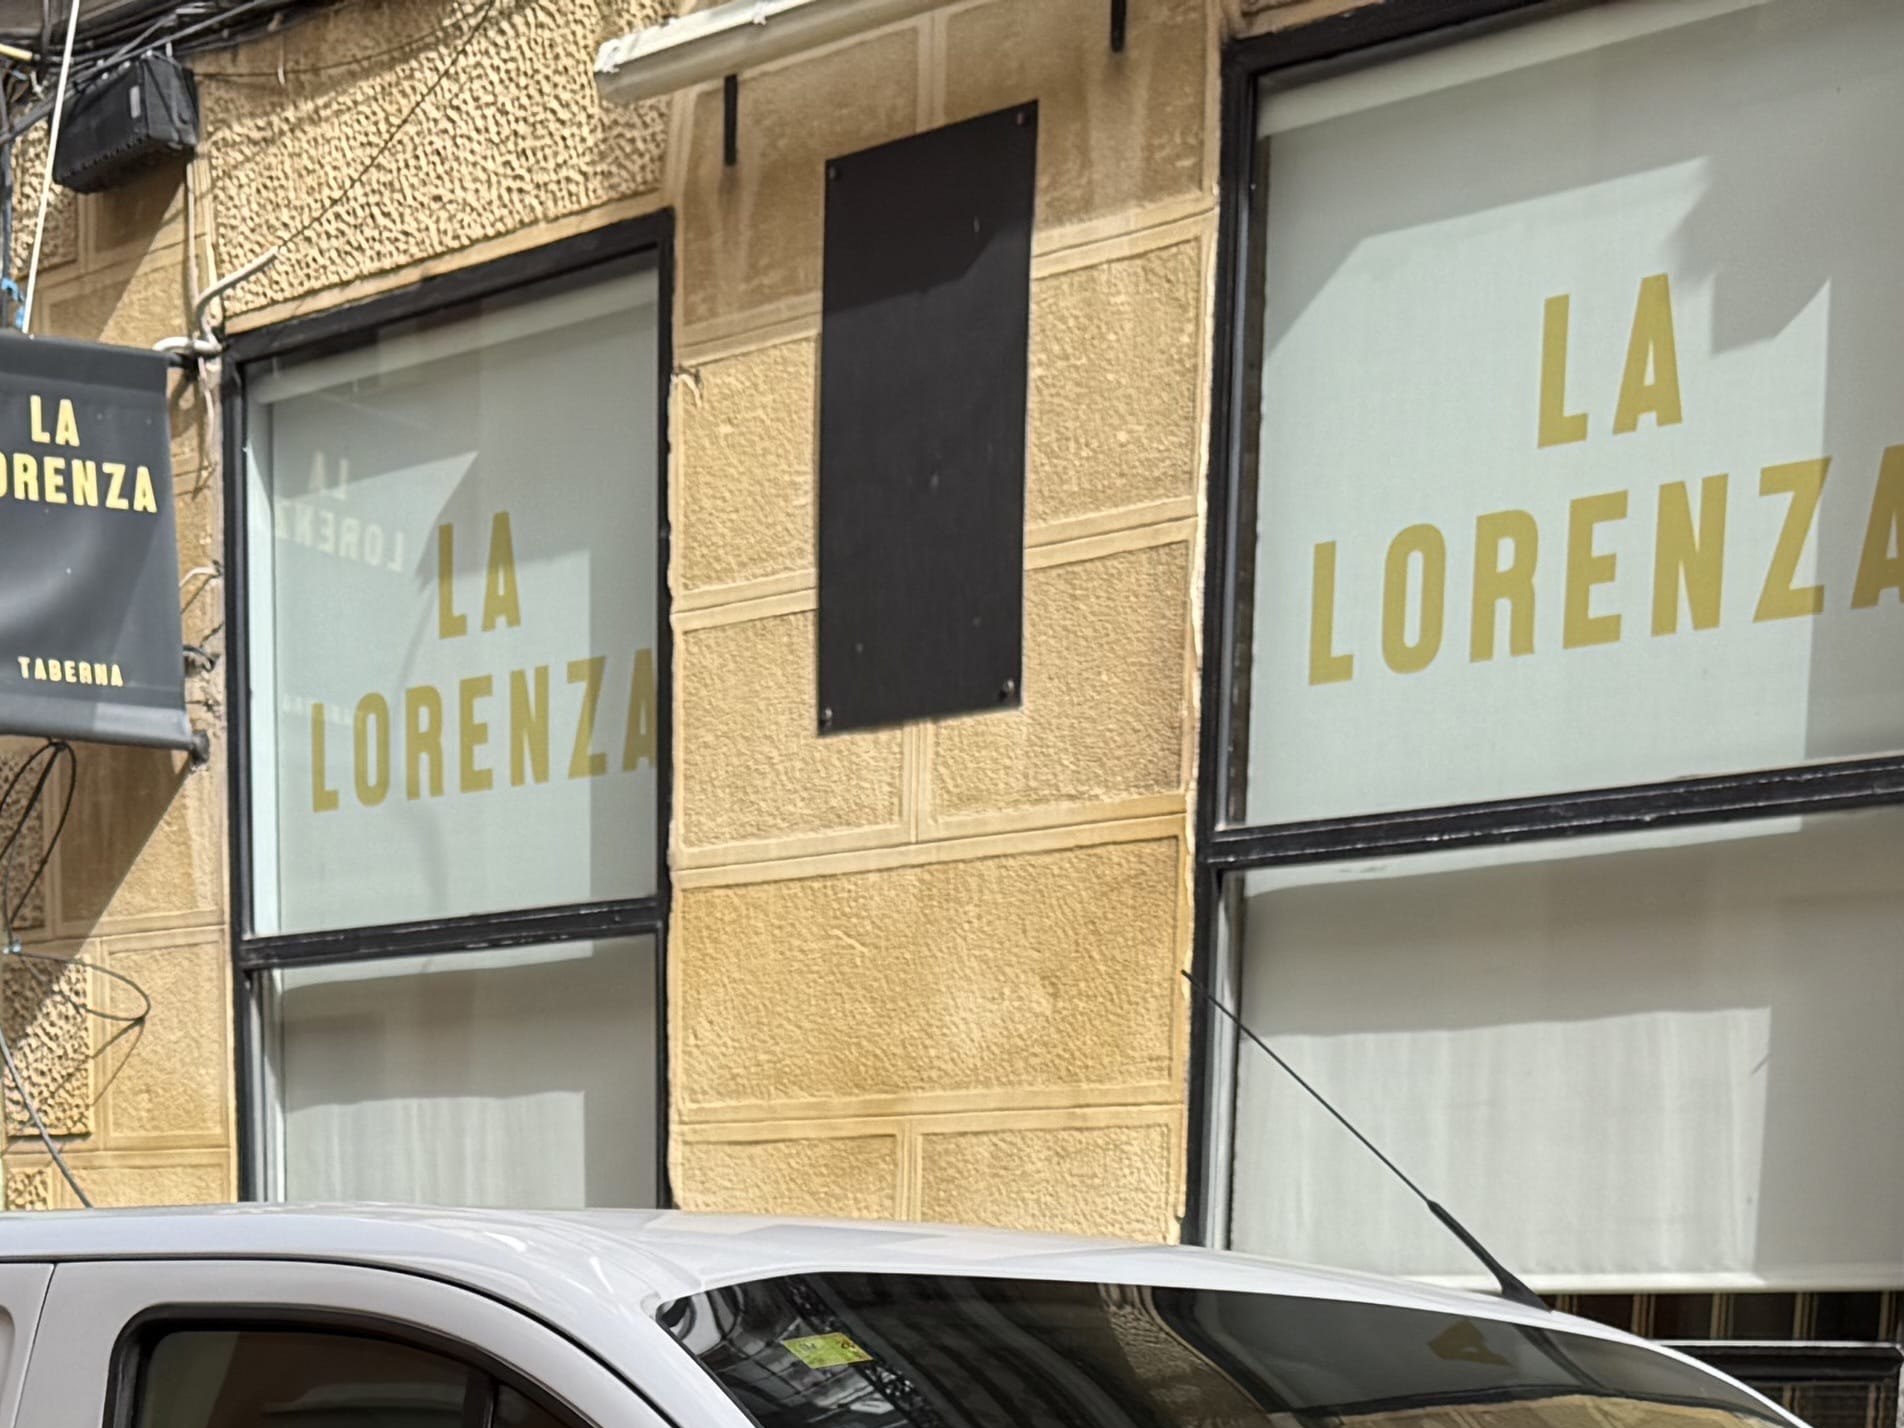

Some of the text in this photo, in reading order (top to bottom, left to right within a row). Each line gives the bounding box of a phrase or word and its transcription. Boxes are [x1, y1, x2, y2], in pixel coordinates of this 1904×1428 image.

[30, 394, 80, 446] LA
[1537, 273, 1682, 449] LA
[438, 510, 521, 639] LA
[17, 655, 124, 688] TABERNA
[311, 646, 657, 813] LORENZA
